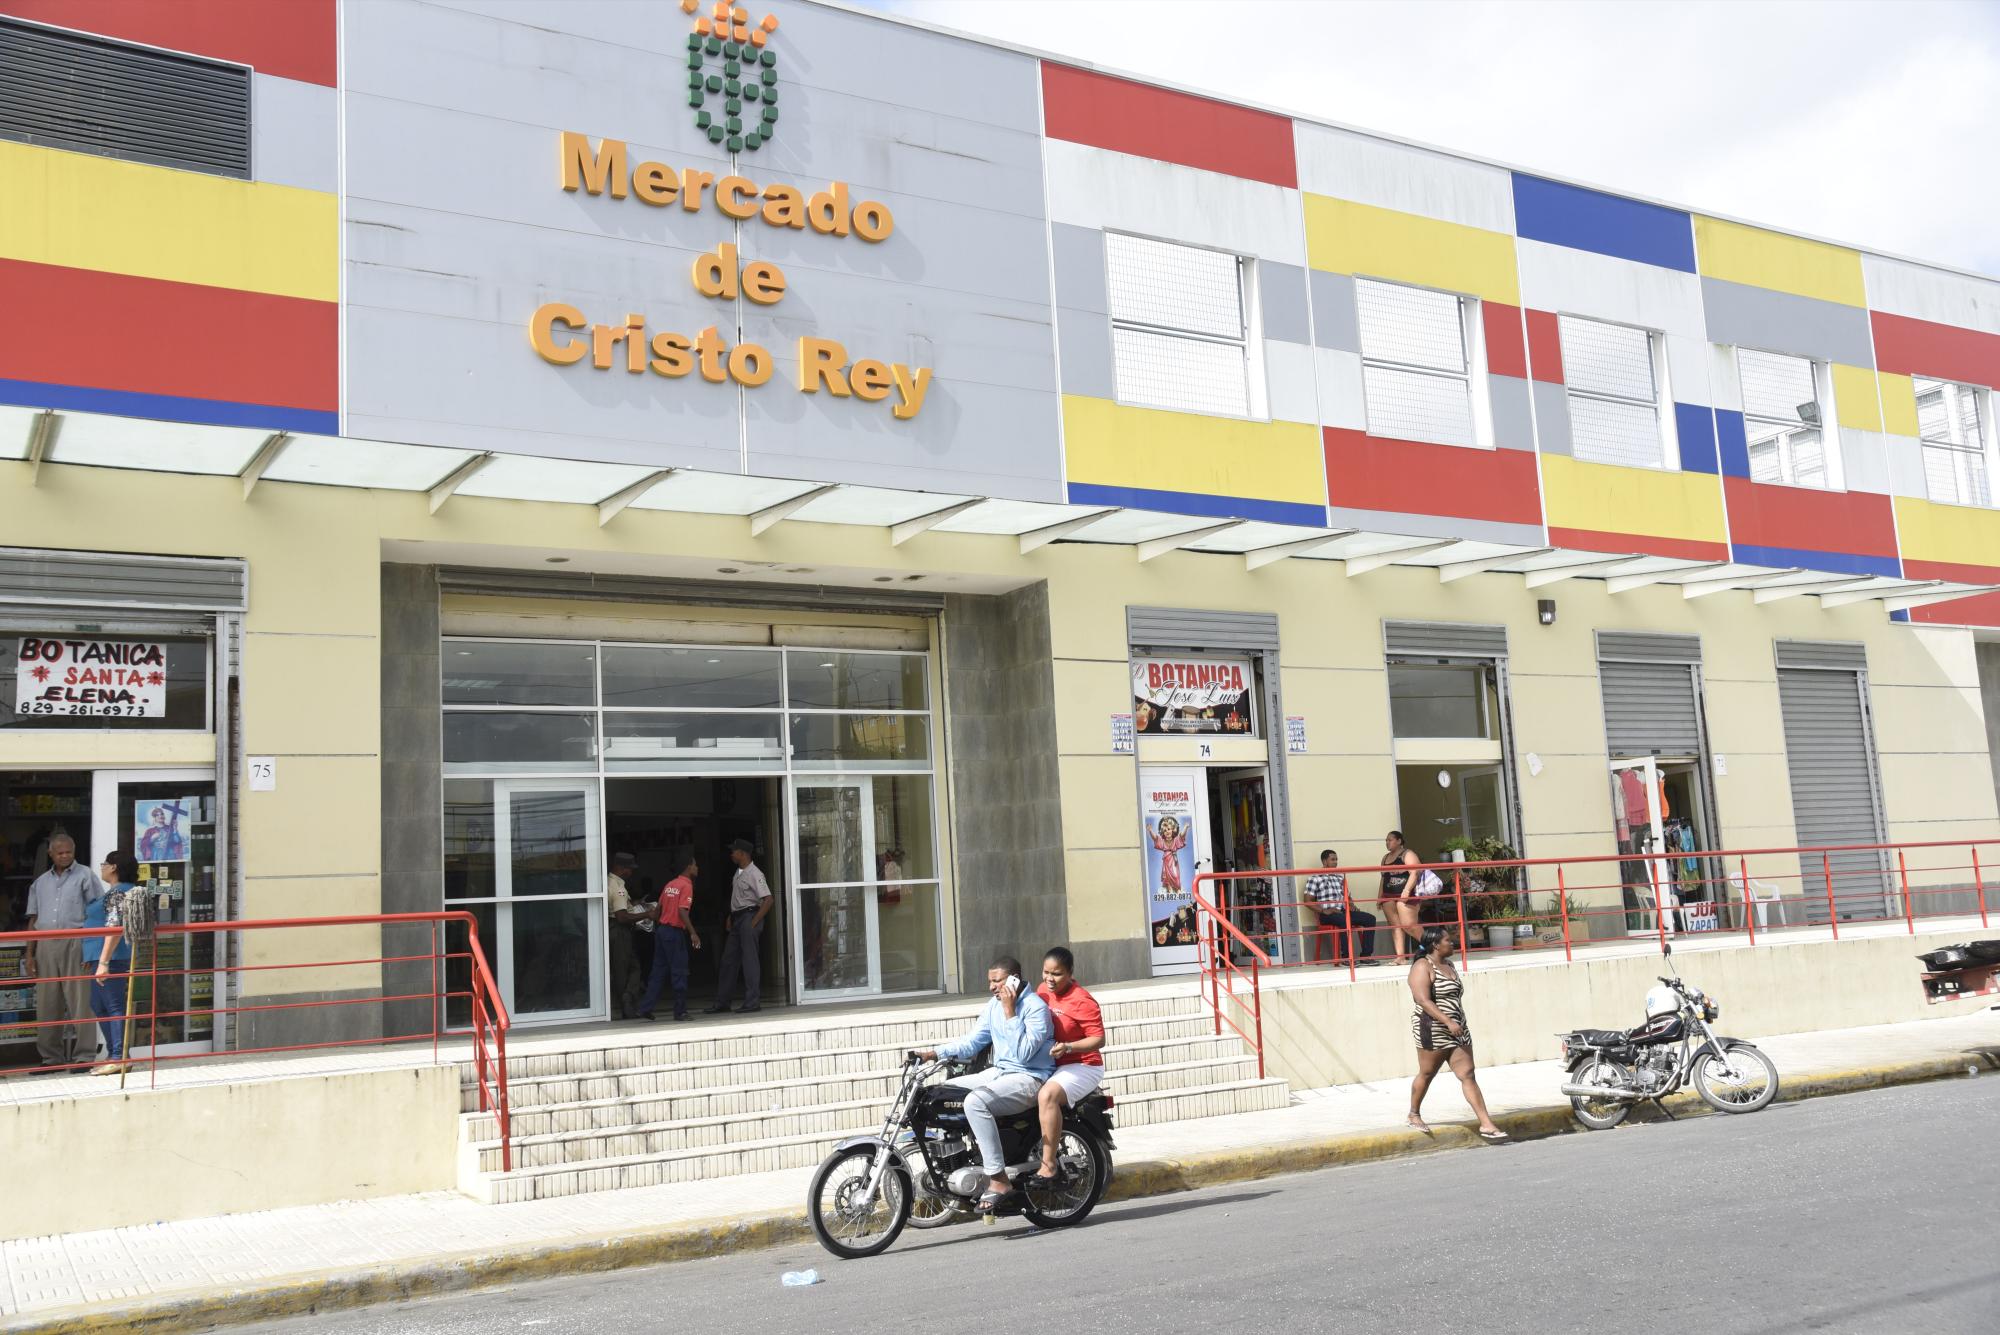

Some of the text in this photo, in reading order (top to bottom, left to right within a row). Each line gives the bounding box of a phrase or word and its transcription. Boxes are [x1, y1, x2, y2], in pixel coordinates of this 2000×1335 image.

[560, 131, 894, 242] Mercado
[692, 242, 786, 305] de
[529, 303, 932, 419] Cristo Rey
[19, 638, 164, 666] BOTANICA
[64, 667, 145, 687] SANTA
[1148, 663, 1243, 690] BOTANICA
[1200, 745, 1211, 757] 74
[253, 764, 271, 778] 75
[1152, 791, 1189, 801] BOTANICA
